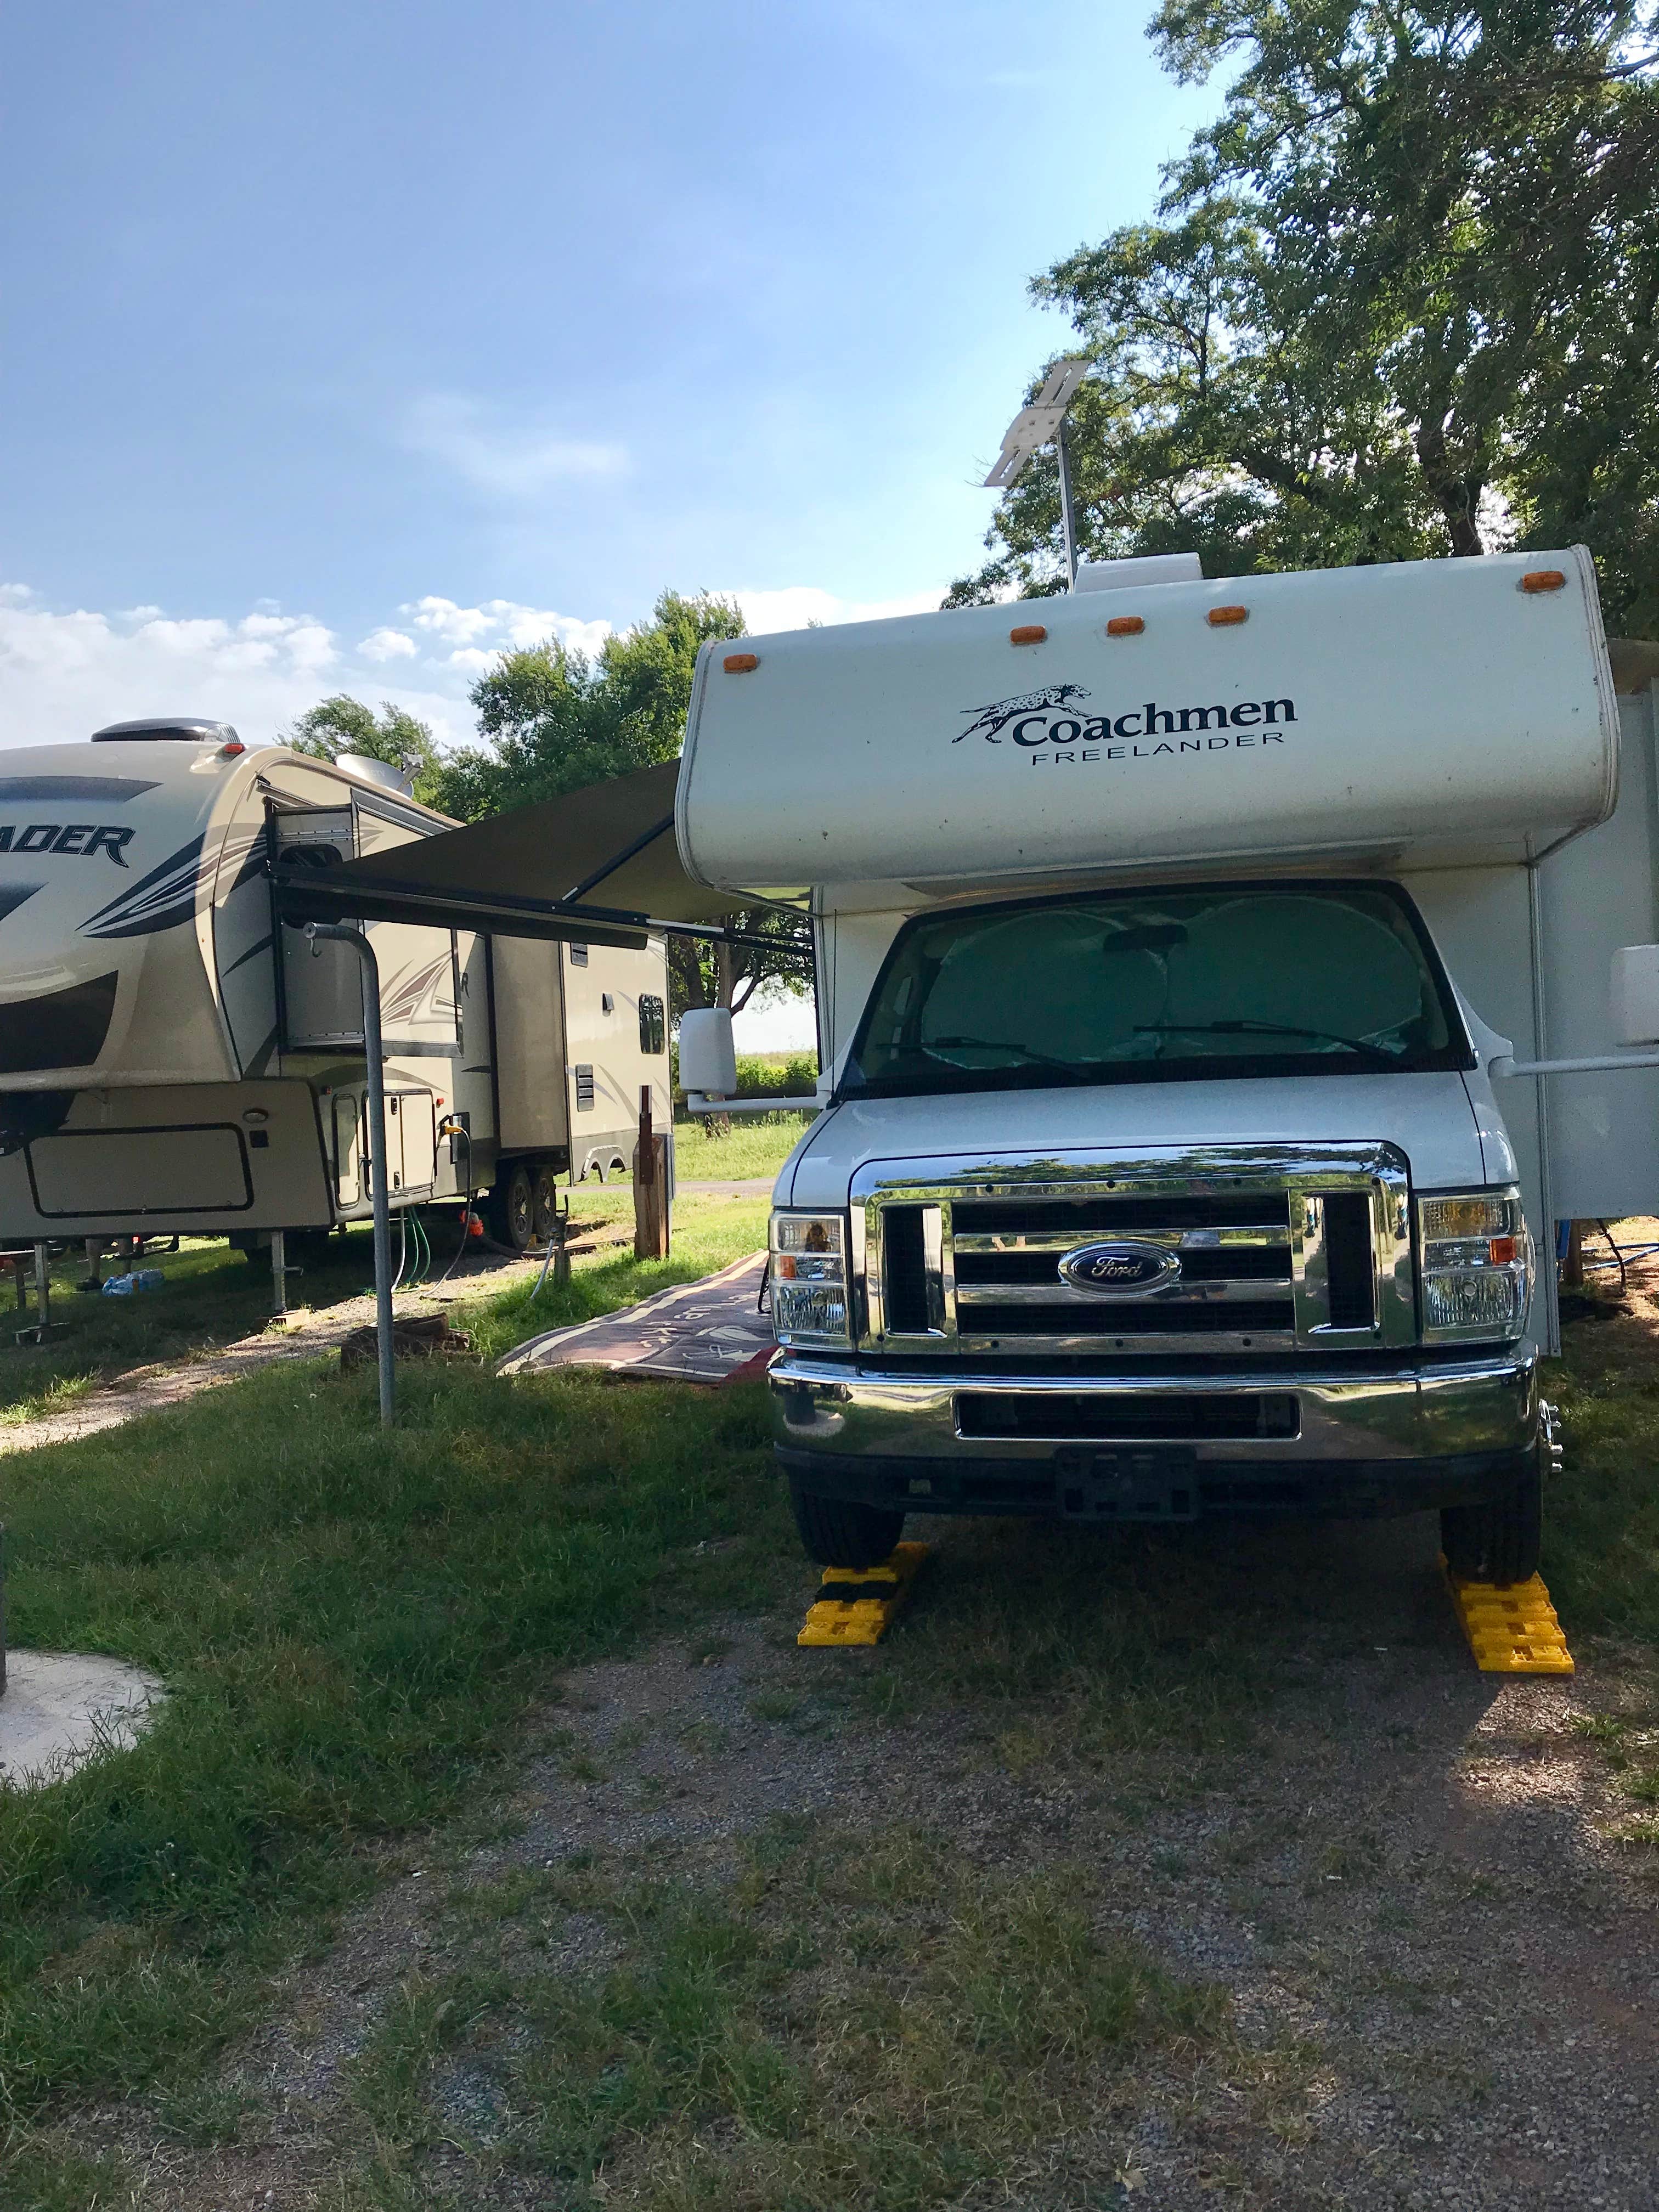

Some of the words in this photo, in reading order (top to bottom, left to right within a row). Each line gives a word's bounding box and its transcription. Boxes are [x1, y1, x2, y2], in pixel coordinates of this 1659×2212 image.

[1012, 698, 1298, 747] Coachmen
[1031, 731, 1285, 766] FREELANDER
[1091, 1256, 1143, 1277] Ford
